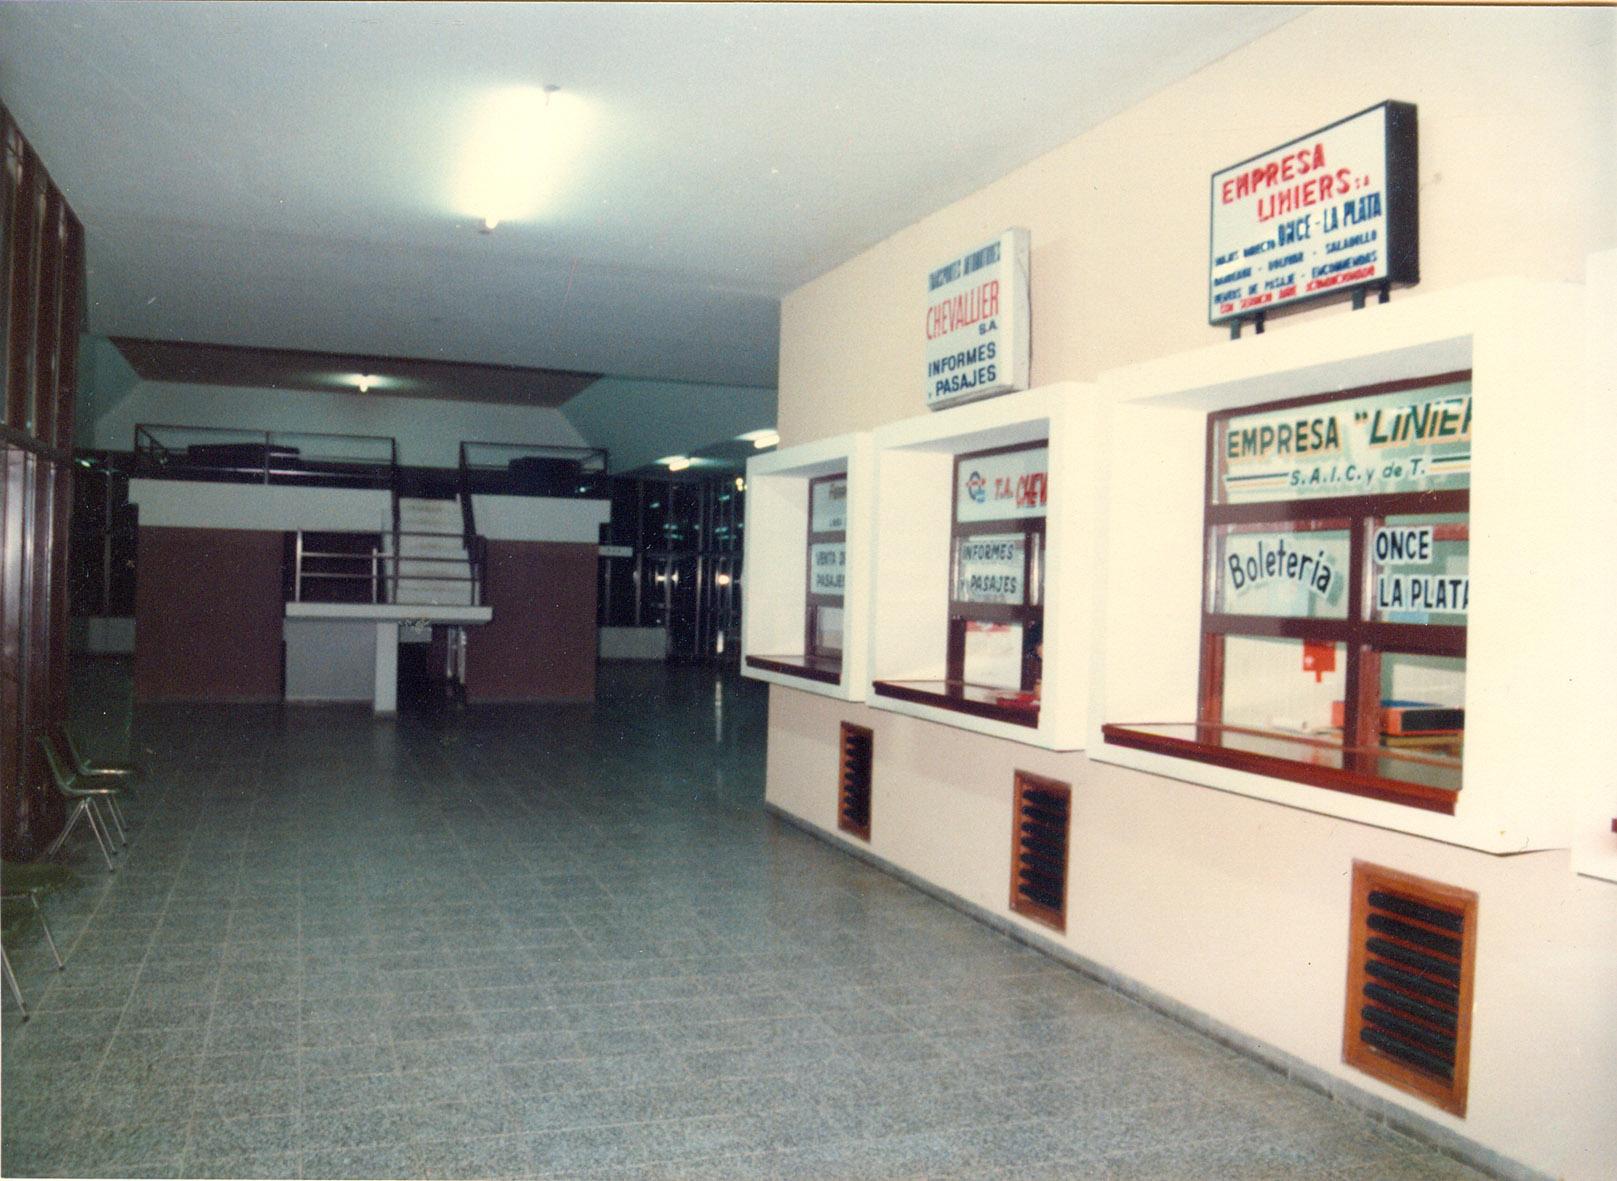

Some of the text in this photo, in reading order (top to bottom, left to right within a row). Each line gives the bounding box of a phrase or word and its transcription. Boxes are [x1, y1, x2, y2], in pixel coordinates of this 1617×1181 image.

[1222, 143, 1325, 205] EMPRESA
[1278, 214, 1311, 246] ONCE
[1324, 207, 1338, 233] LA
[1344, 192, 1381, 226] PLATA
[927, 279, 999, 340] CHEVALLIER
[928, 341, 996, 378] INFORMES
[935, 364, 996, 396] PASAJES
[1227, 415, 1340, 459] EMPRESA
[1382, 461, 1402, 479] de
[1376, 529, 1429, 561] ONCE
[1379, 578, 1402, 608] LA
